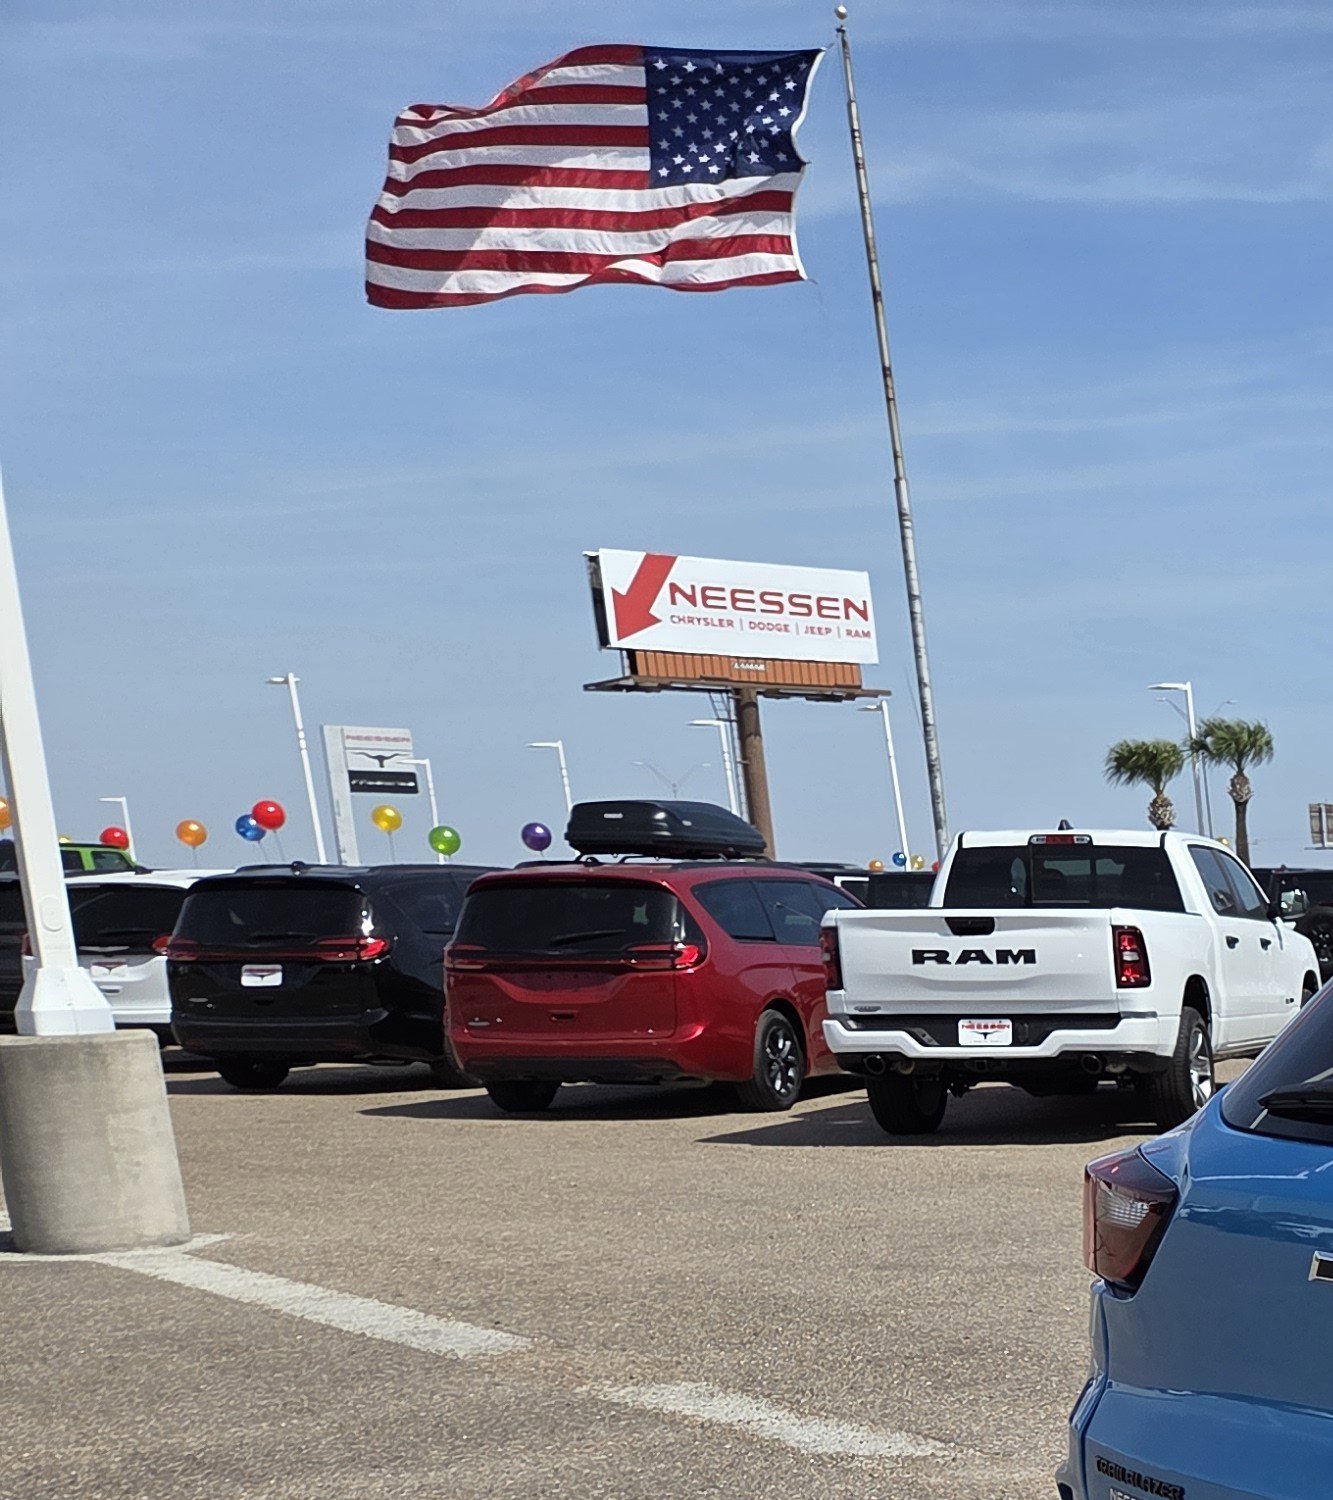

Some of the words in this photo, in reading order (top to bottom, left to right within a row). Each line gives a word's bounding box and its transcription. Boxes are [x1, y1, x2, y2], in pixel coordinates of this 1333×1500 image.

[668, 582, 869, 622] NEESSEN
[669, 614, 735, 629] CHRYSLER
[748, 620, 790, 633] DODGE
[804, 625, 832, 636] JEEP
[845, 628, 872, 640] RAM
[912, 949, 1037, 965] RAM
